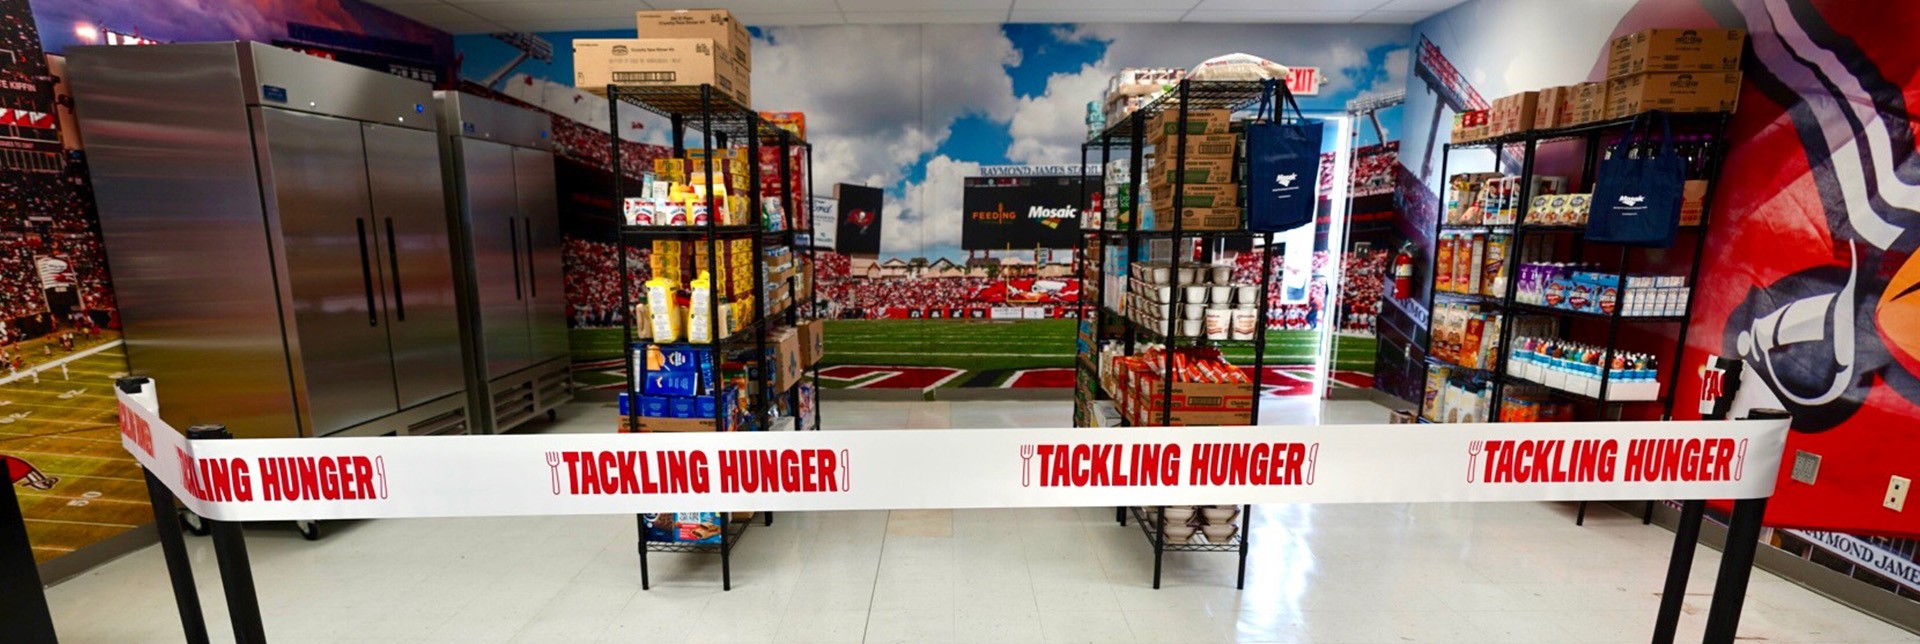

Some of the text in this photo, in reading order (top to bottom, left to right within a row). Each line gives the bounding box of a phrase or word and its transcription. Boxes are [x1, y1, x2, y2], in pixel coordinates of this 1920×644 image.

[980, 166, 1031, 177] RAYMOND
[1032, 165, 1065, 176] JAMES
[972, 207, 1016, 222] FEEDING
[1028, 204, 1078, 219] Mosaic
[258, 456, 377, 503] HUNGER
[562, 449, 838, 495] TACKLING HUNGER
[1037, 443, 1306, 488] TACKLING HUNGER
[1483, 438, 1736, 483] TACKLING HUNGER
